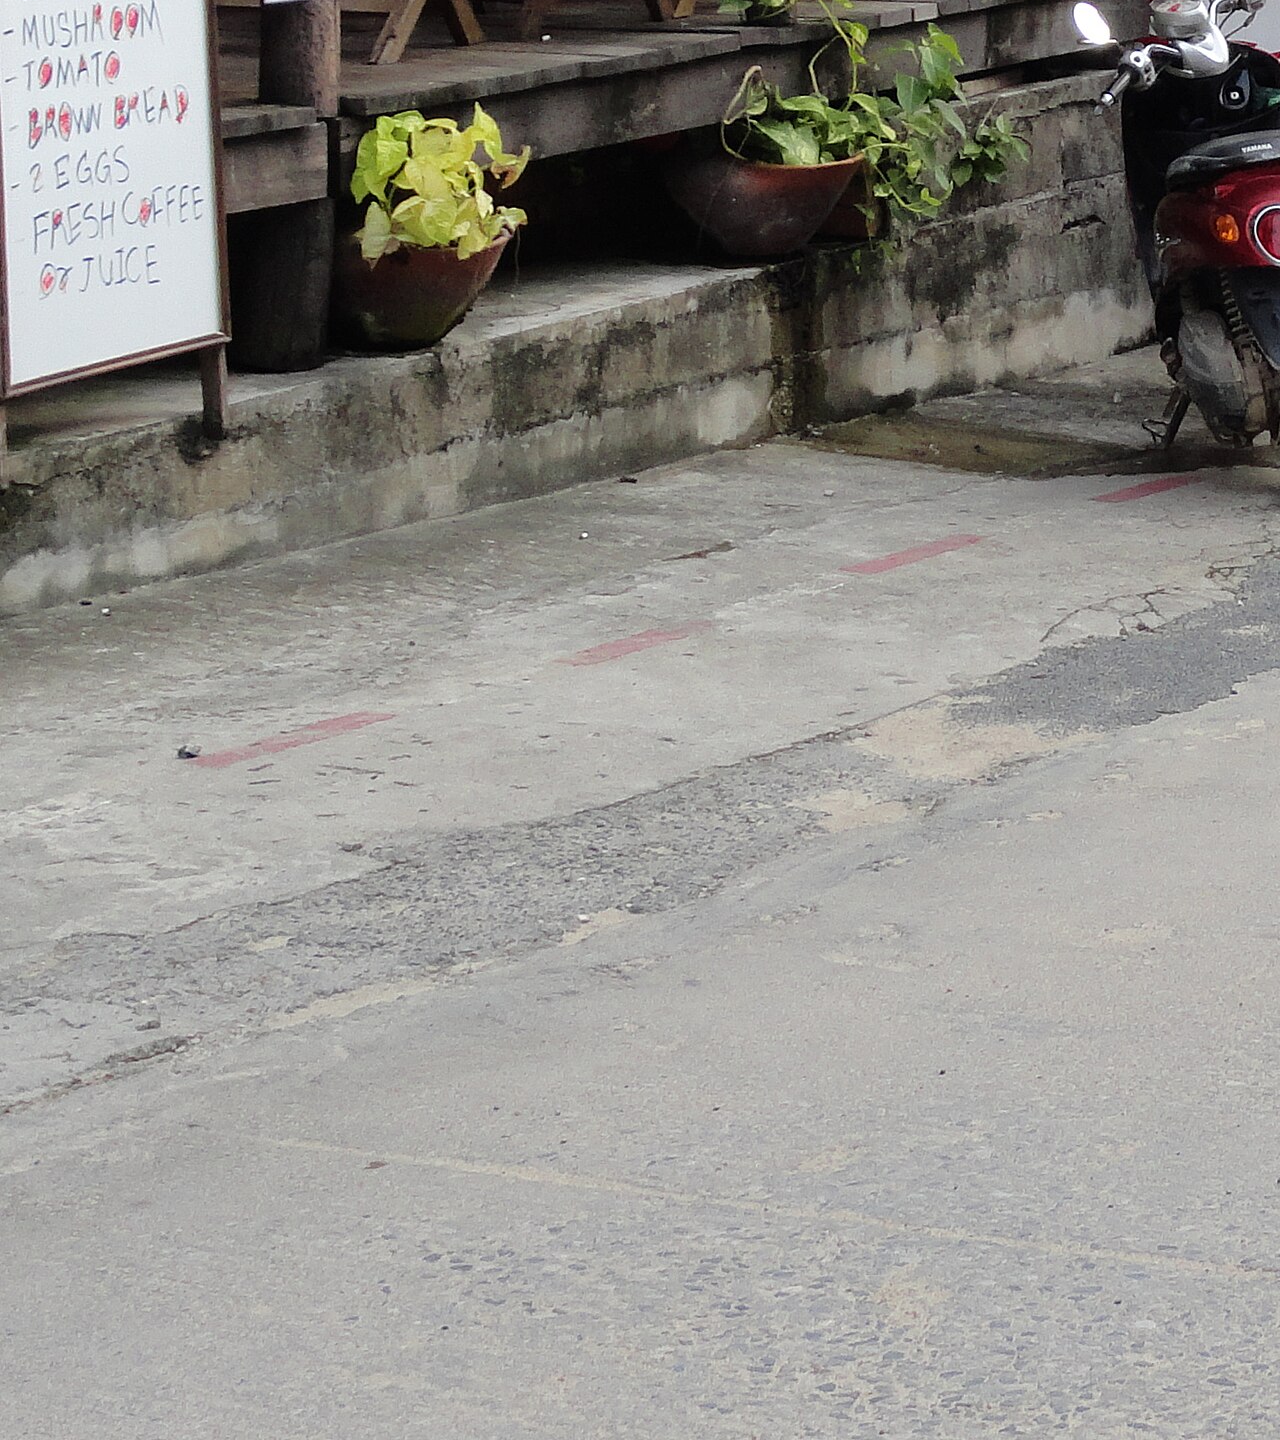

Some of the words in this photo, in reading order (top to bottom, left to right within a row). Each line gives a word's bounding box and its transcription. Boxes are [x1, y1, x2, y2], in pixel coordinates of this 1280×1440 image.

[114, 84, 191, 129] BREAD
[54, 145, 131, 190] EGGS
[1241, 143, 1273, 154] YAMAHA
[34, 202, 116, 254] FRESH
[122, 185, 205, 228] COFFEE
[79, 245, 161, 293] JUICE
